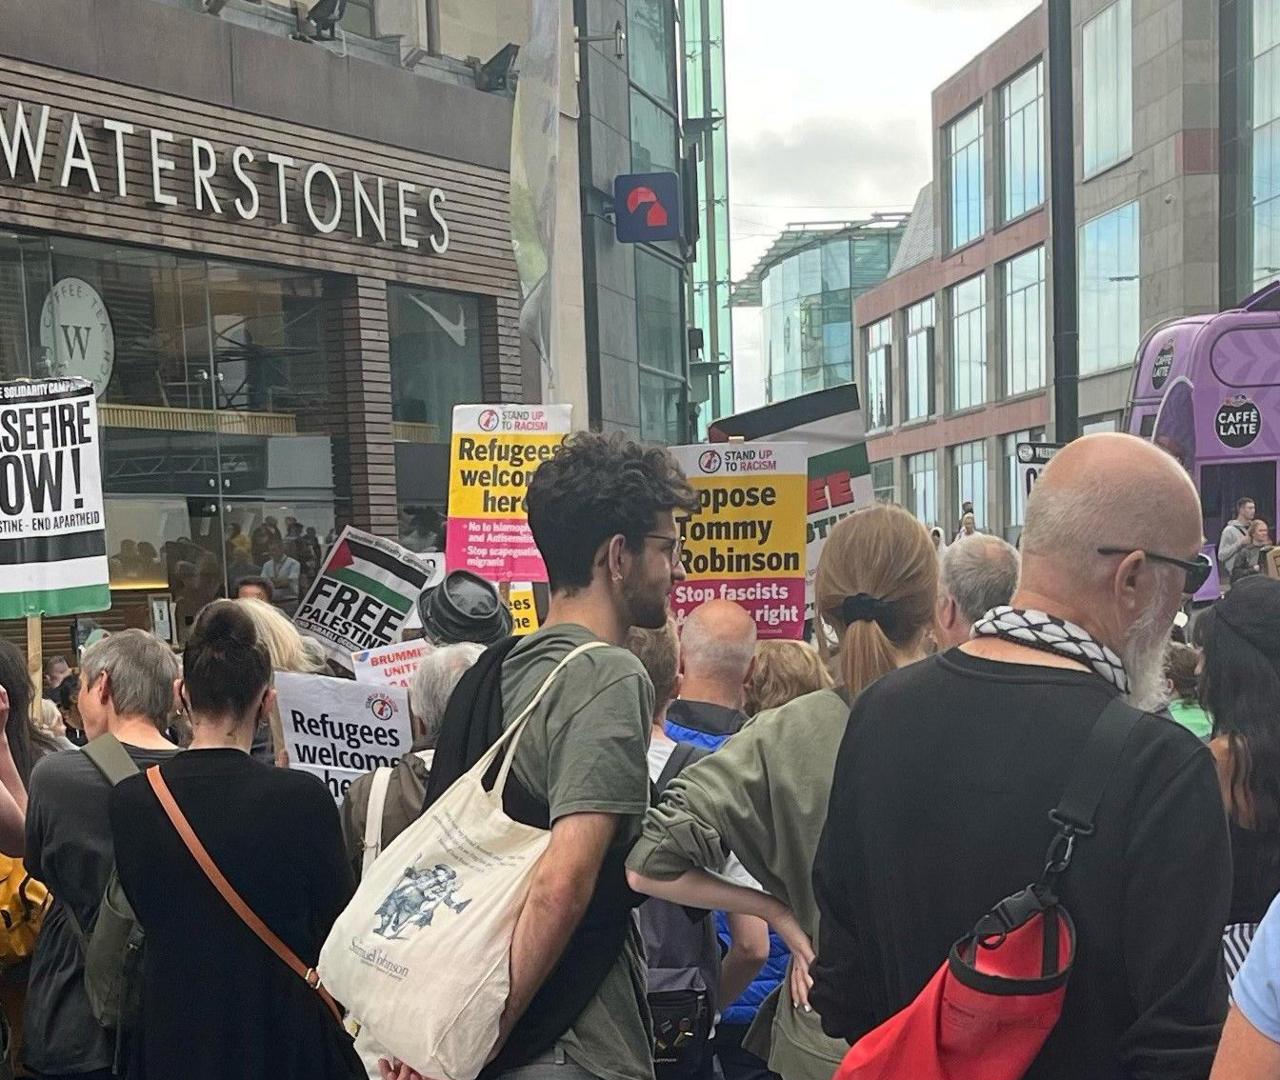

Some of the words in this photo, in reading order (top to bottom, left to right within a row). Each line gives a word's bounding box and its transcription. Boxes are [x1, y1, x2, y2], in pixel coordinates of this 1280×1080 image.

[61, 324, 92, 360] W
[4, 384, 48, 399] SOLIDARITY
[502, 410, 529, 421] STAND
[531, 411, 544, 421] UP
[502, 420, 512, 431] TO
[514, 421, 549, 431] RACISM
[1218, 409, 1258, 423] CAFFÈ
[1219, 422, 1258, 436] LATTE
[724, 450, 755, 461] STAND
[758, 450, 773, 461] UP
[725, 461, 737, 472] TO
[739, 460, 777, 472] RACISM
[698, 486, 777, 514] ppose
[32, 516, 51, 531] END
[53, 511, 100, 530] APARTHEID
[676, 516, 773, 546] Tommy
[680, 547, 800, 573] Robinson
[676, 584, 715, 604] Stop
[719, 583, 789, 601] fascists
[306, 576, 405, 644] FREE
[756, 604, 800, 626] right
[298, 603, 391, 652] PALESTIN
[370, 647, 422, 667] BRUMMI
[291, 710, 401, 748] Refugees
